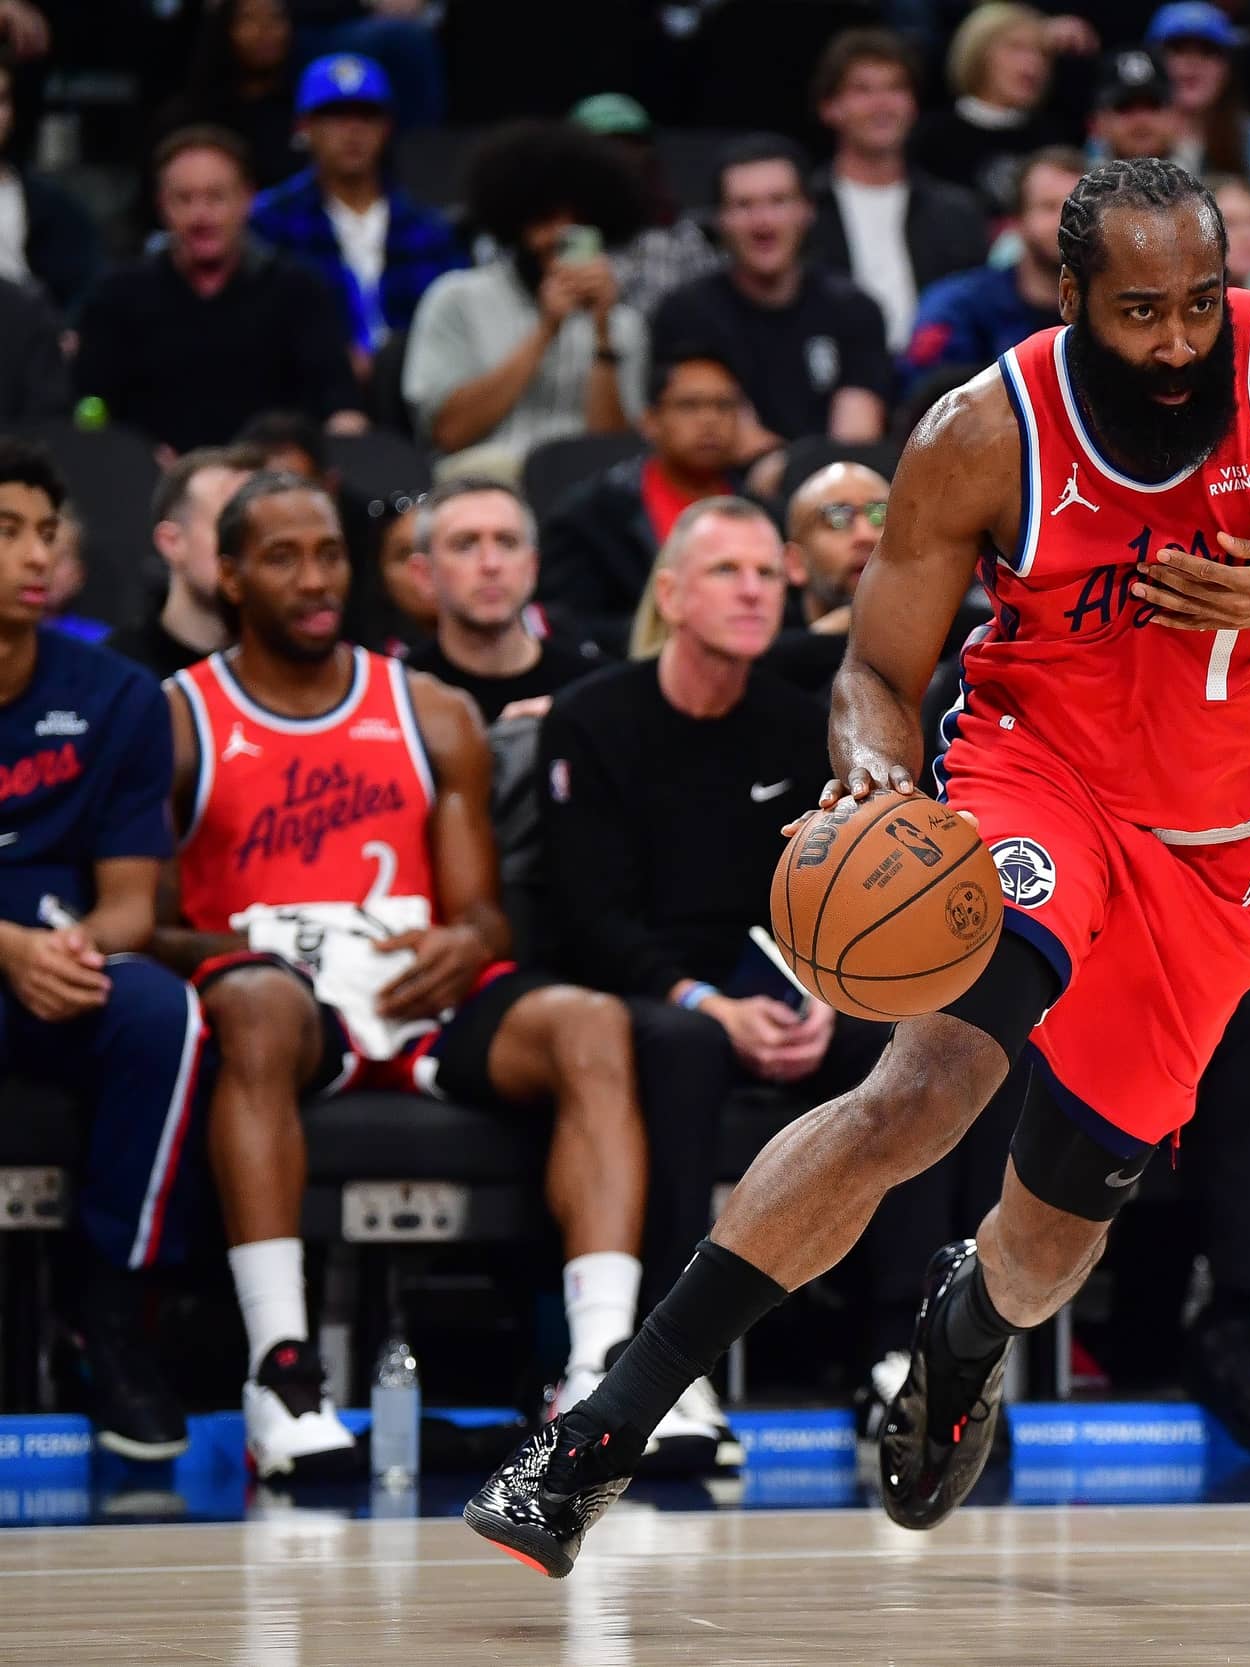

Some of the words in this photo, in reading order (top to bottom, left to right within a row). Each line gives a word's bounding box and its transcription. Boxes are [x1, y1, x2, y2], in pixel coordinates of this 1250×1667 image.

[284, 756, 349, 808] Los
[238, 774, 404, 868] Angeles
[362, 840, 397, 907] 2
